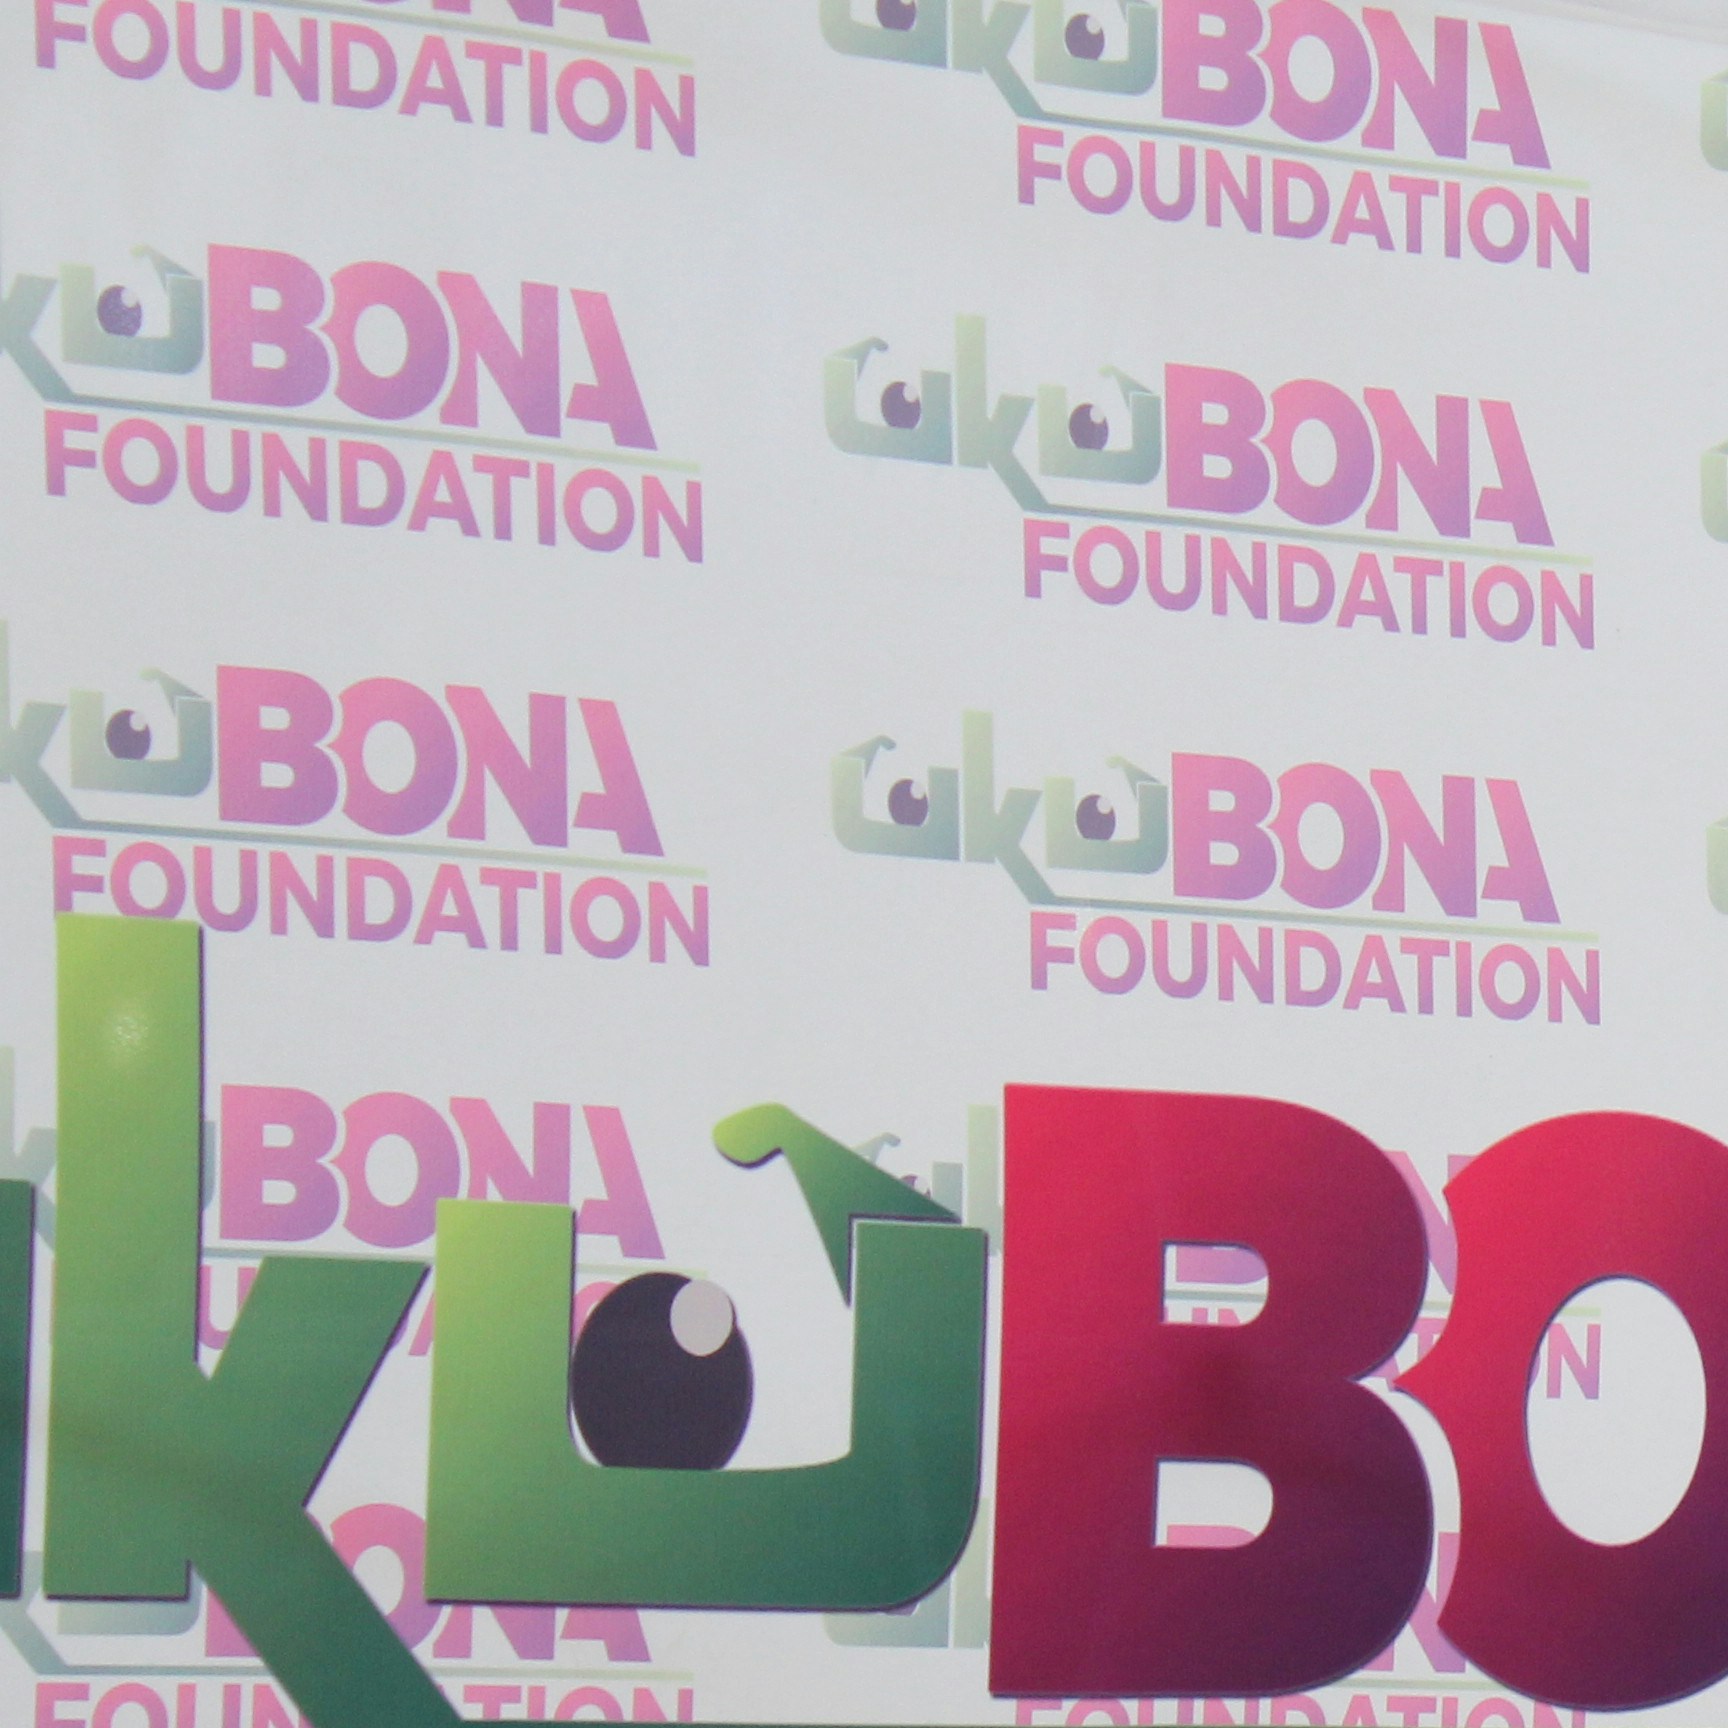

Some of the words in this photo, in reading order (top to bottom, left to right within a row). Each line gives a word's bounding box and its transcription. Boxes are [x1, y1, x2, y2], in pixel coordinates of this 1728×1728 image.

[34, 0, 696, 157] FOUNDATION
[1016, 124, 1590, 274] FOUNDATION
[44, 409, 703, 564] FOUNDATION
[1023, 518, 1595, 650] FOUNDATION
[53, 835, 710, 967] FOUNDATION
[1030, 911, 1600, 1026] FOUNDATION
